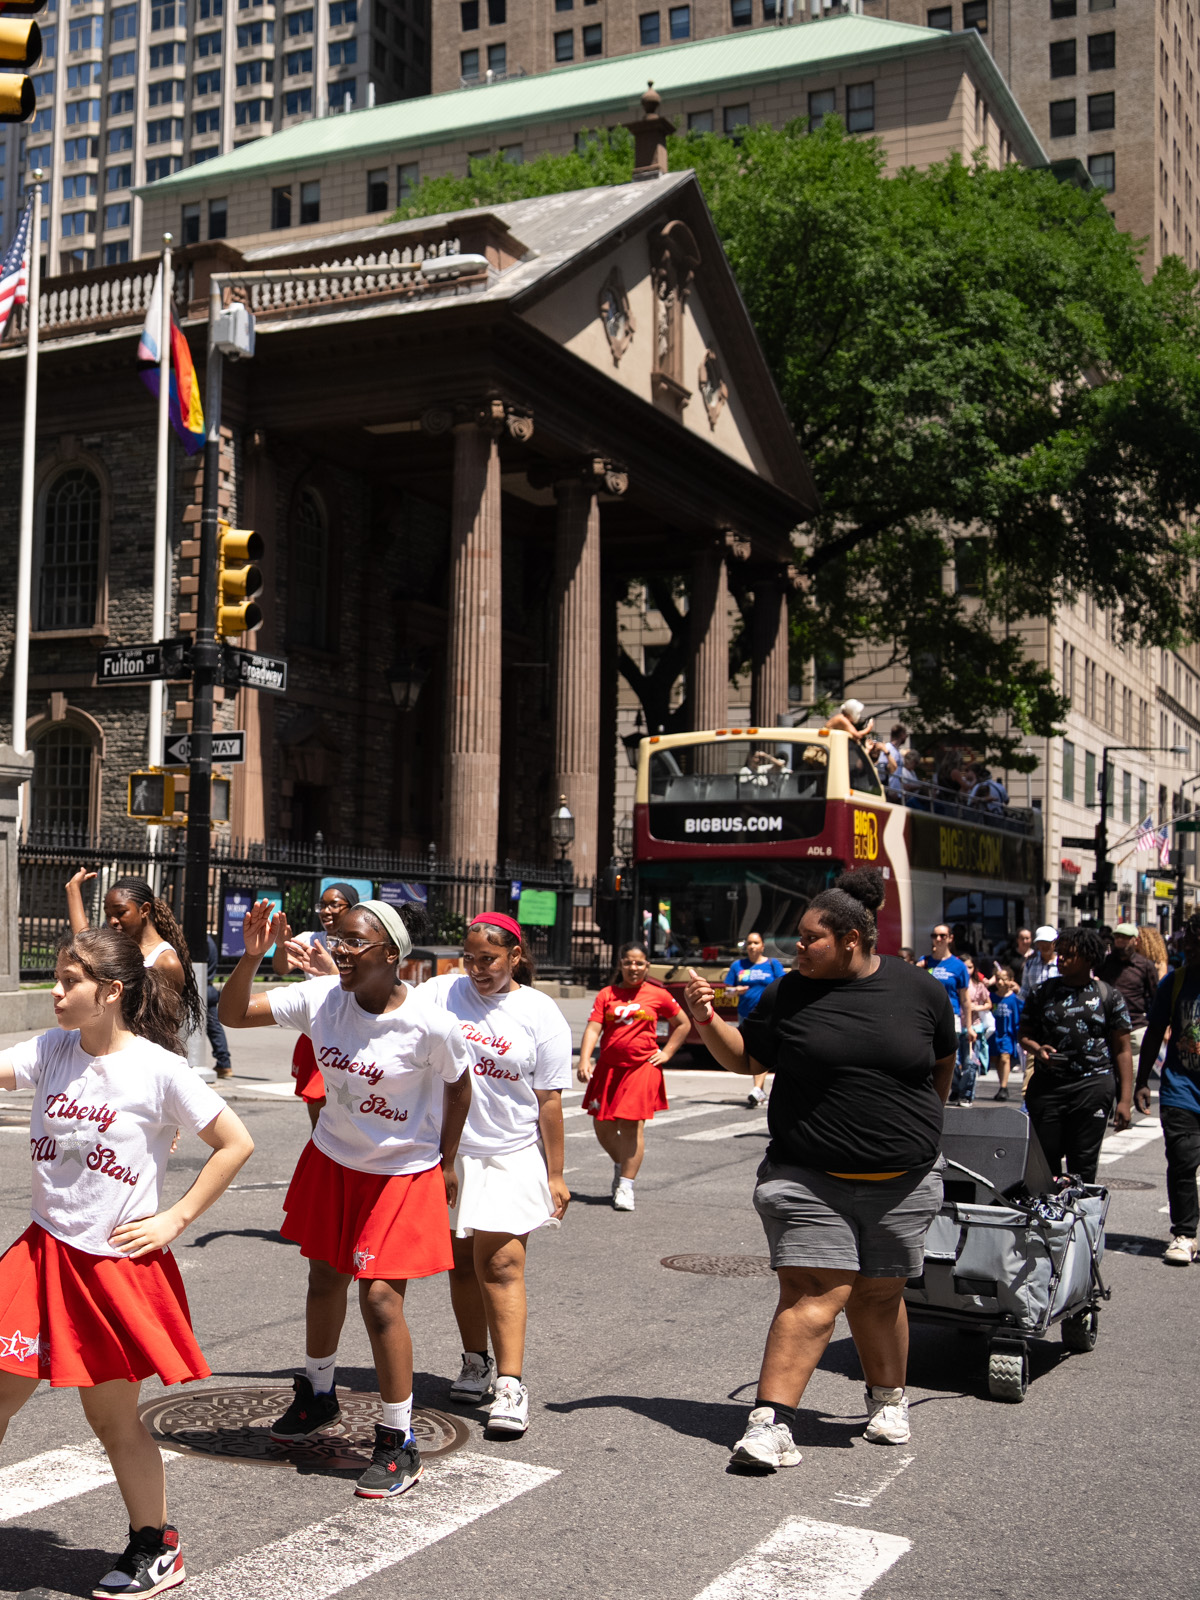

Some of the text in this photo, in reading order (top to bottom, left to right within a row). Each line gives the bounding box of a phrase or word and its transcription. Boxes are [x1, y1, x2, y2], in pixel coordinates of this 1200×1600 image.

[103, 656, 144, 676] Fulton
[146, 653, 155, 665] ST
[242, 661, 283, 687] Broadway
[684, 816, 783, 833] BIGBUS.COM
[853, 809, 869, 835] BIG
[459, 1023, 513, 1056] Liberty
[317, 1046, 385, 1086] Liberty
[473, 1055, 520, 1082] Stars
[44, 1092, 118, 1134] Liberty
[359, 1093, 409, 1122] Stars
[30, 1135, 140, 1187] All Stars
